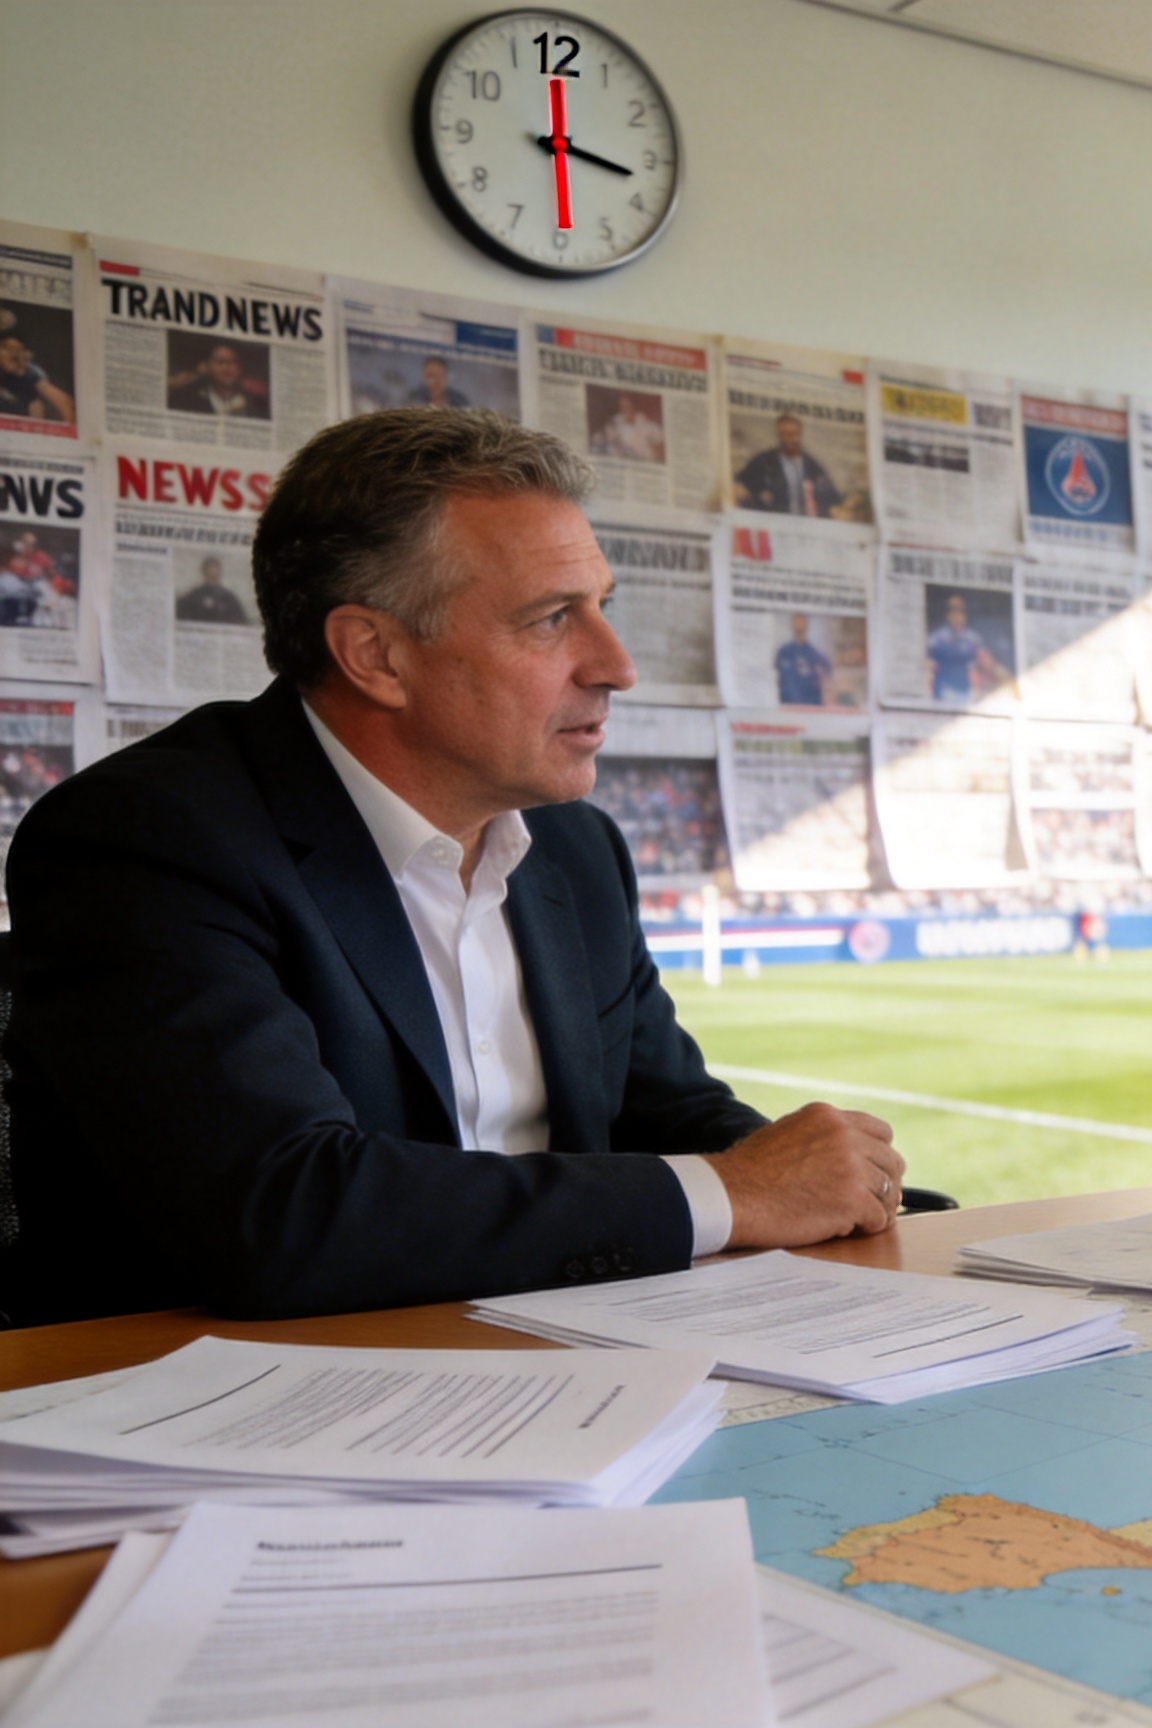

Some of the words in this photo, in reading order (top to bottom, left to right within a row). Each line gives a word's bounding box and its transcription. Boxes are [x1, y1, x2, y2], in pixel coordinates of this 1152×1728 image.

[532, 31, 581, 78] 12
[464, 70, 502, 103] 10
[627, 100, 647, 128] 2
[455, 119, 475, 144] 9
[470, 166, 489, 192] 8
[506, 203, 525, 230] 7
[224, 295, 323, 342] NEWS
